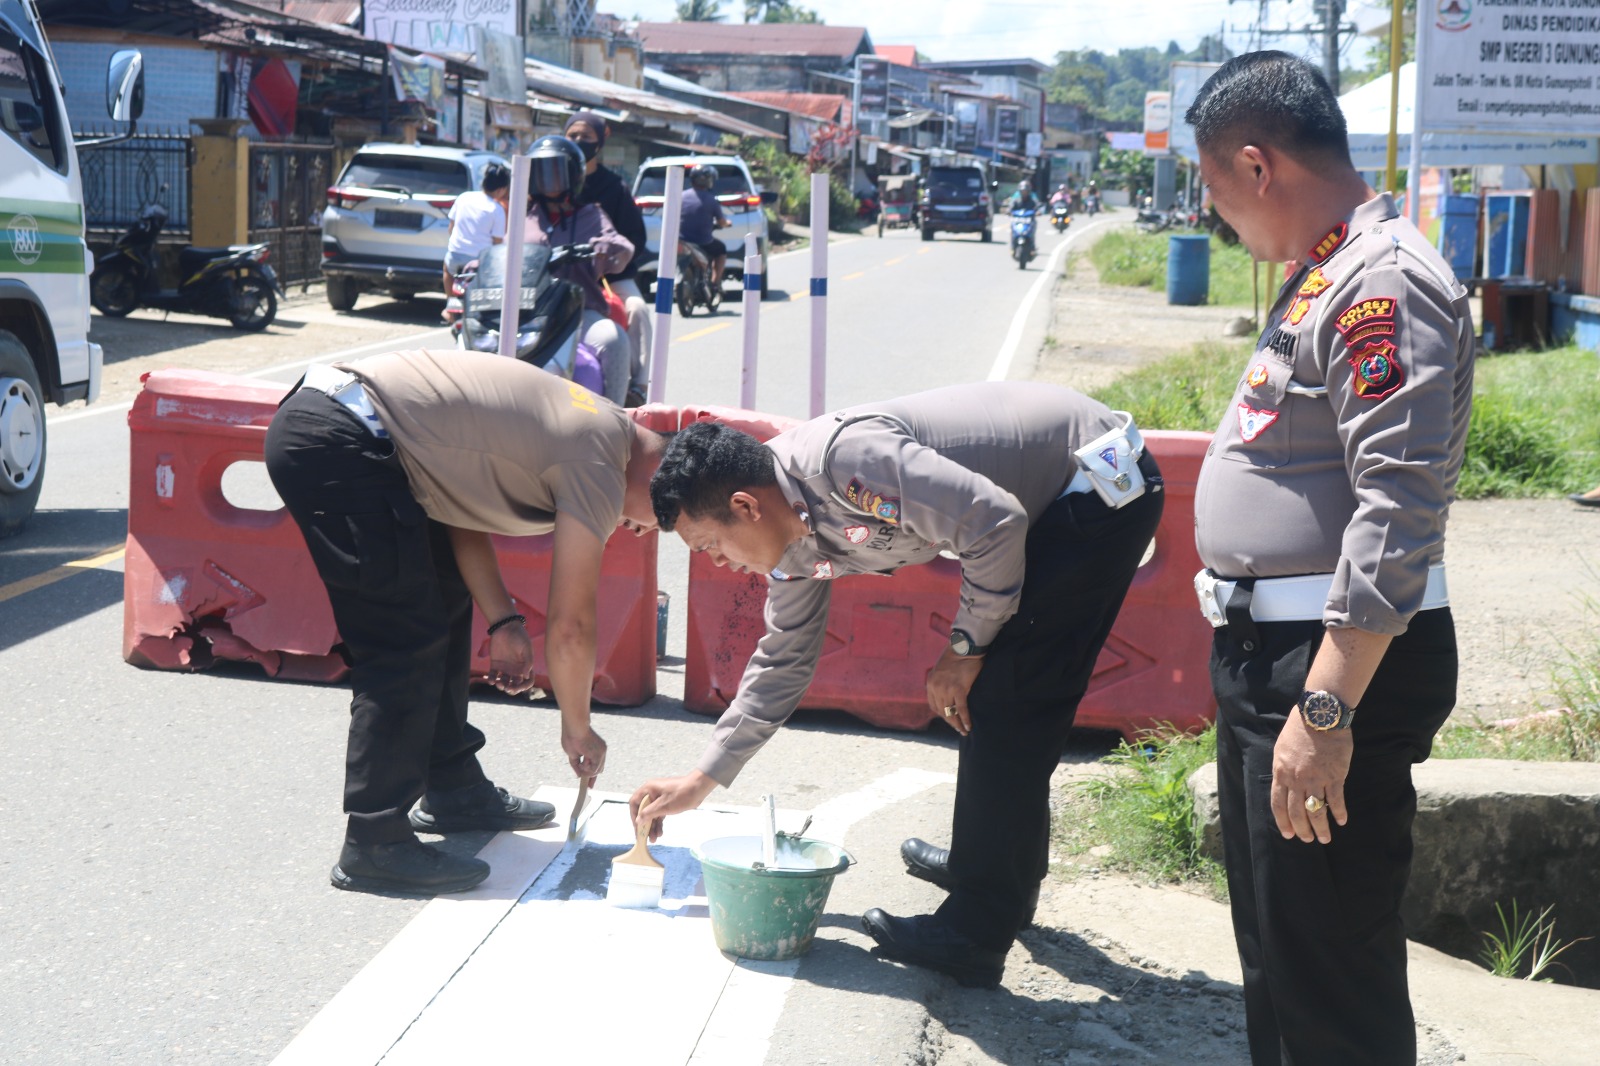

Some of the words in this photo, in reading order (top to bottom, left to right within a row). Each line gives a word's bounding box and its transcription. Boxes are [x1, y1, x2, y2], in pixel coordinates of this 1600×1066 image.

[1502, 14, 1538, 31] DINAS
[1479, 41, 1502, 62] SMP
[1504, 42, 1542, 63] NEGERI
[1545, 42, 1552, 63] 3
[1457, 98, 1479, 113] Email
[1340, 300, 1390, 326] POLRES
[1346, 307, 1386, 327] NIAS
